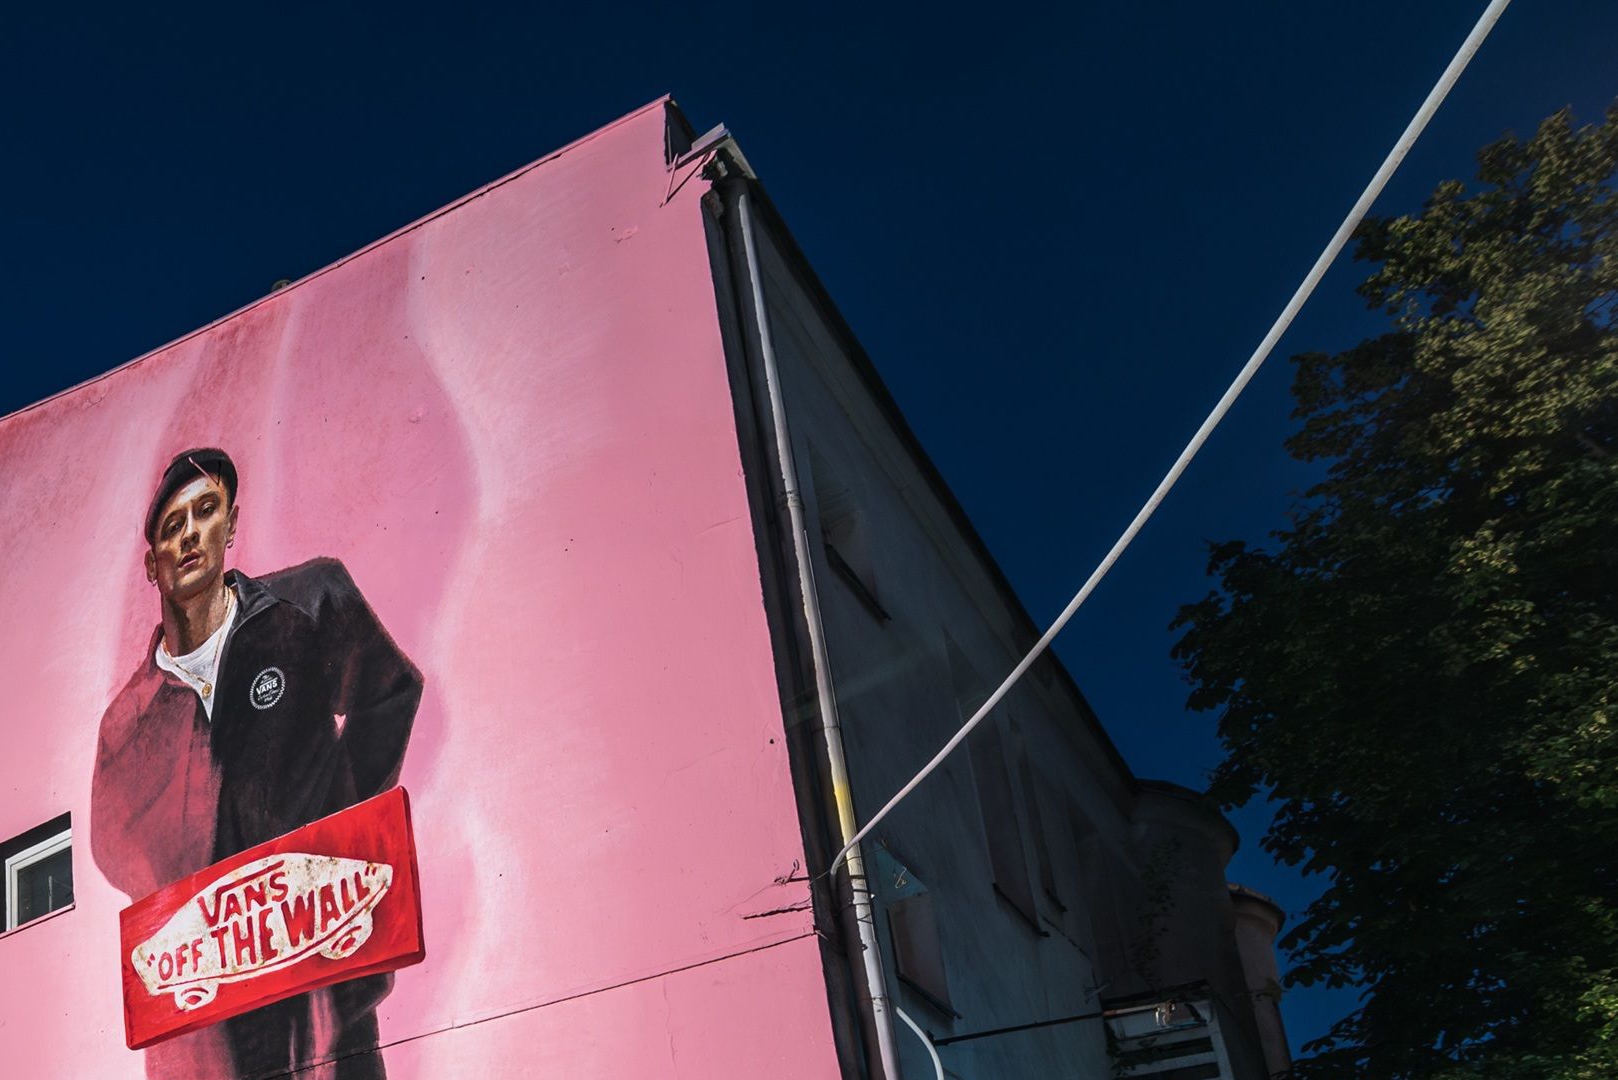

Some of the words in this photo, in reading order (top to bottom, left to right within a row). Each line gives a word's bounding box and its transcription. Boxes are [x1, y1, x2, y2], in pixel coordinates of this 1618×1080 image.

[256, 679, 278, 695] VANS
[198, 863, 289, 927] VANS
[211, 912, 281, 969] THE
